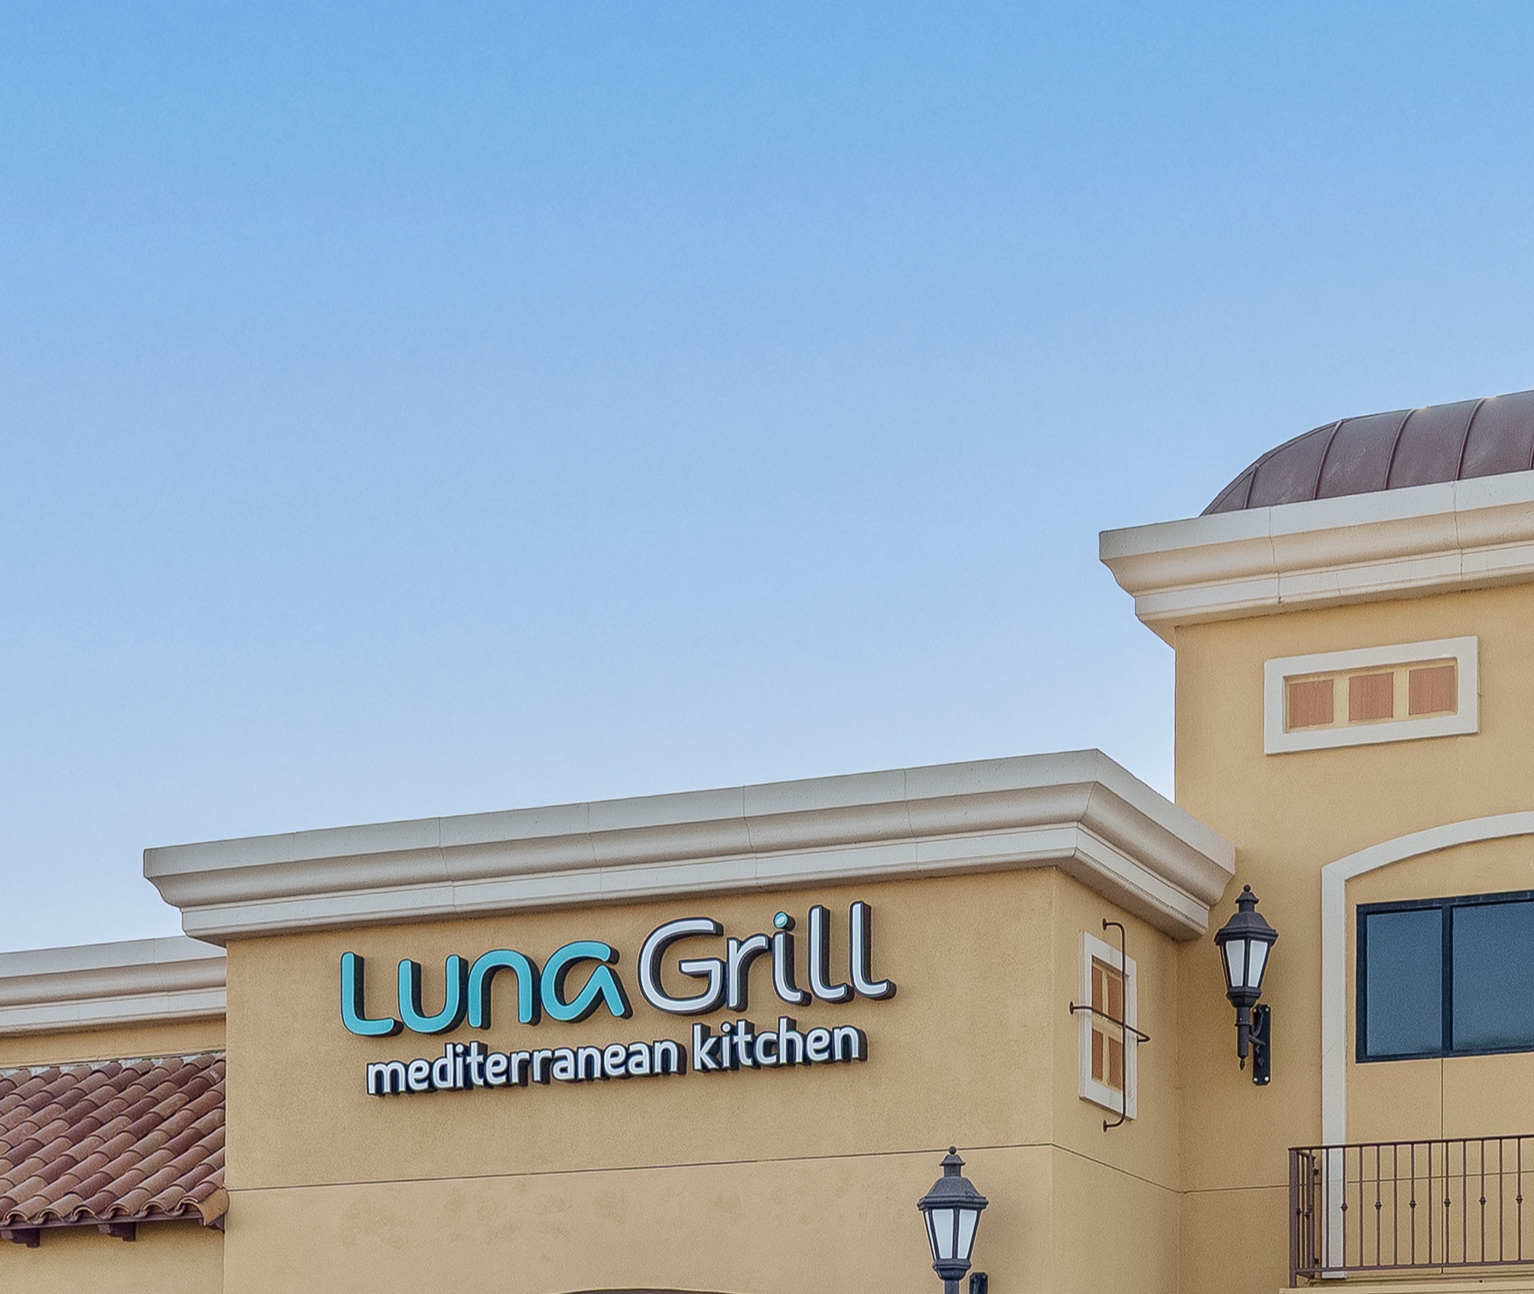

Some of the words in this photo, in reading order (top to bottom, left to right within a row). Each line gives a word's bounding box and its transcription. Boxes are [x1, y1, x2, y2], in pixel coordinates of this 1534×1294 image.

[340, 940, 632, 1036] Luna
[638, 901, 896, 1014] Grill
[367, 1039, 686, 1096] mediterranean
[693, 1017, 867, 1072] kitchen
